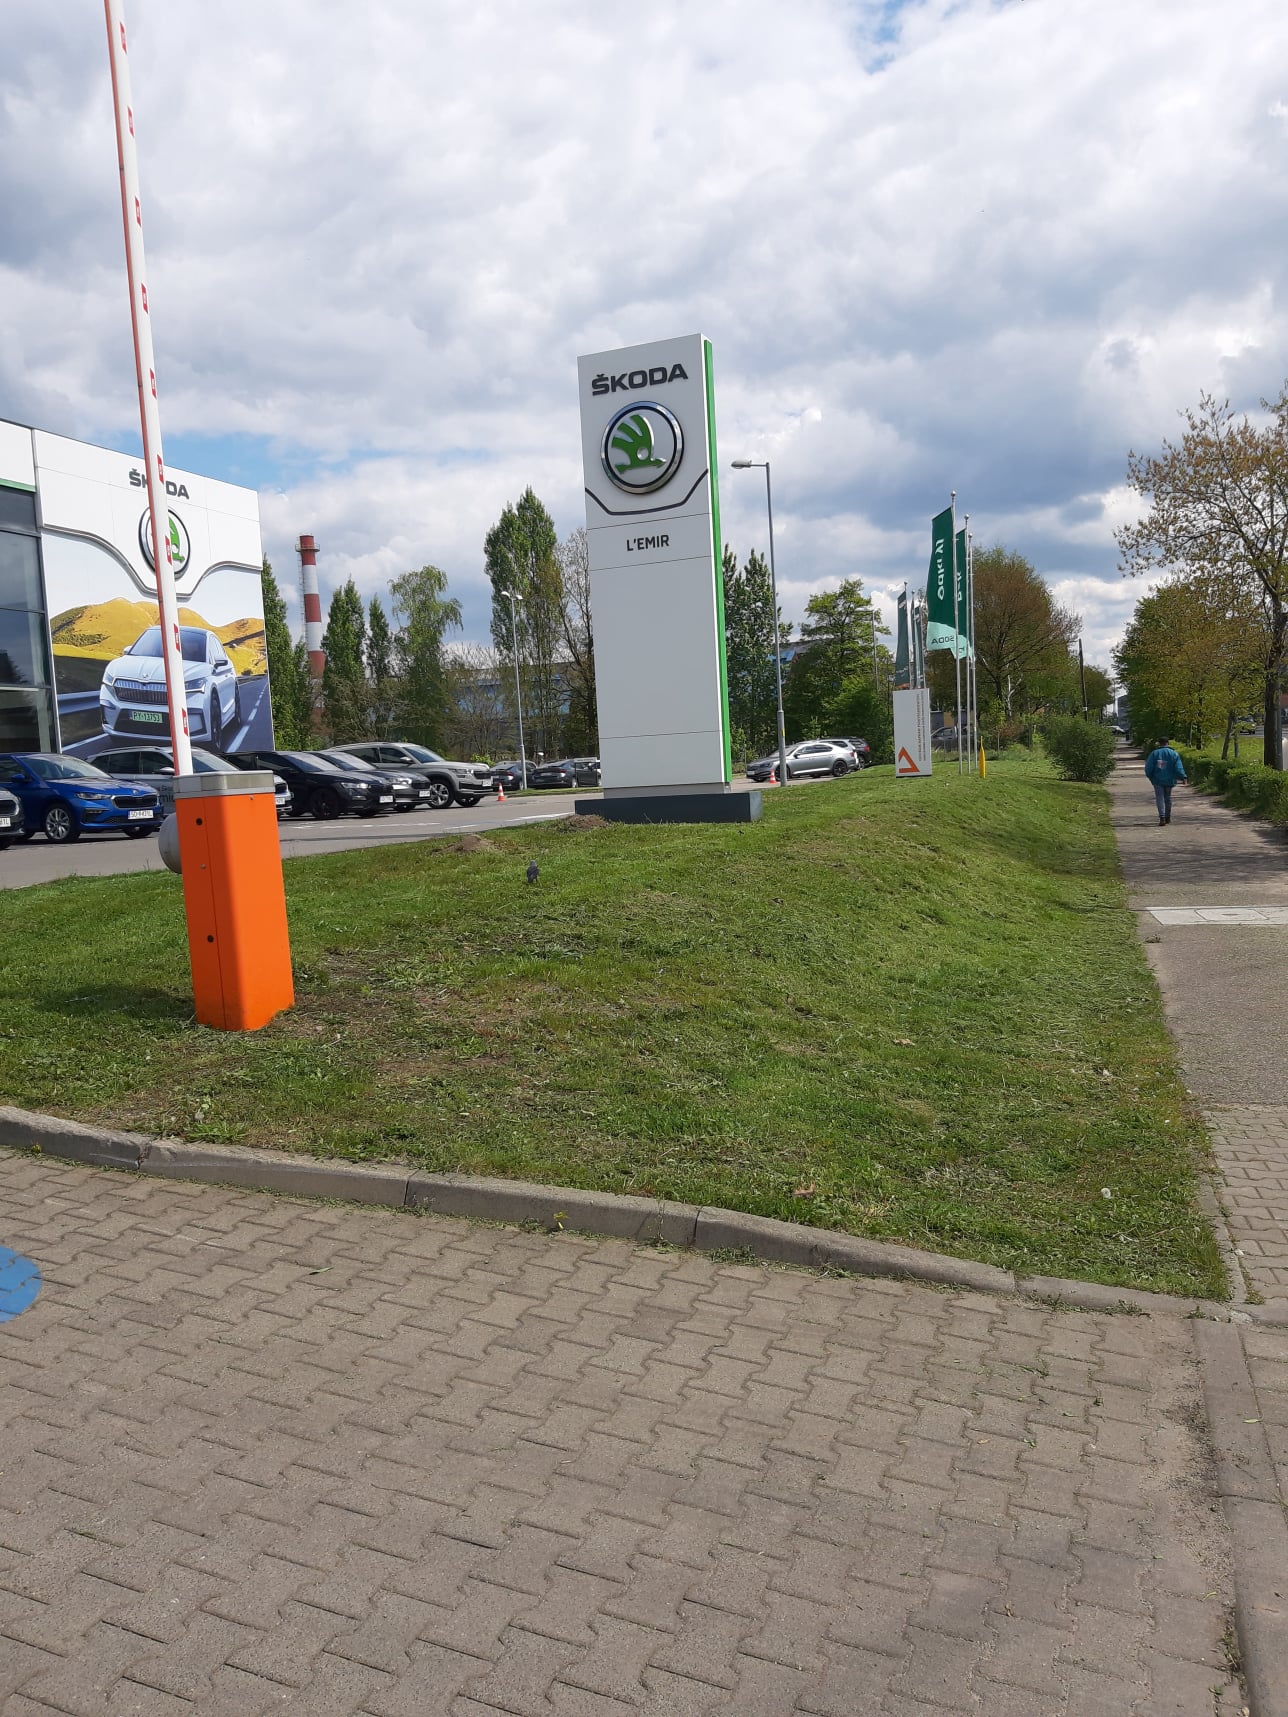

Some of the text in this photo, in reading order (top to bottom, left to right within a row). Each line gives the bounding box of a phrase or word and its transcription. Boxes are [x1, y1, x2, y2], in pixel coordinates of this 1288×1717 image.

[592, 363, 688, 396] ŠKODA
[128, 468, 190, 500] ŠDA
[627, 534, 670, 552] L'EMIR
